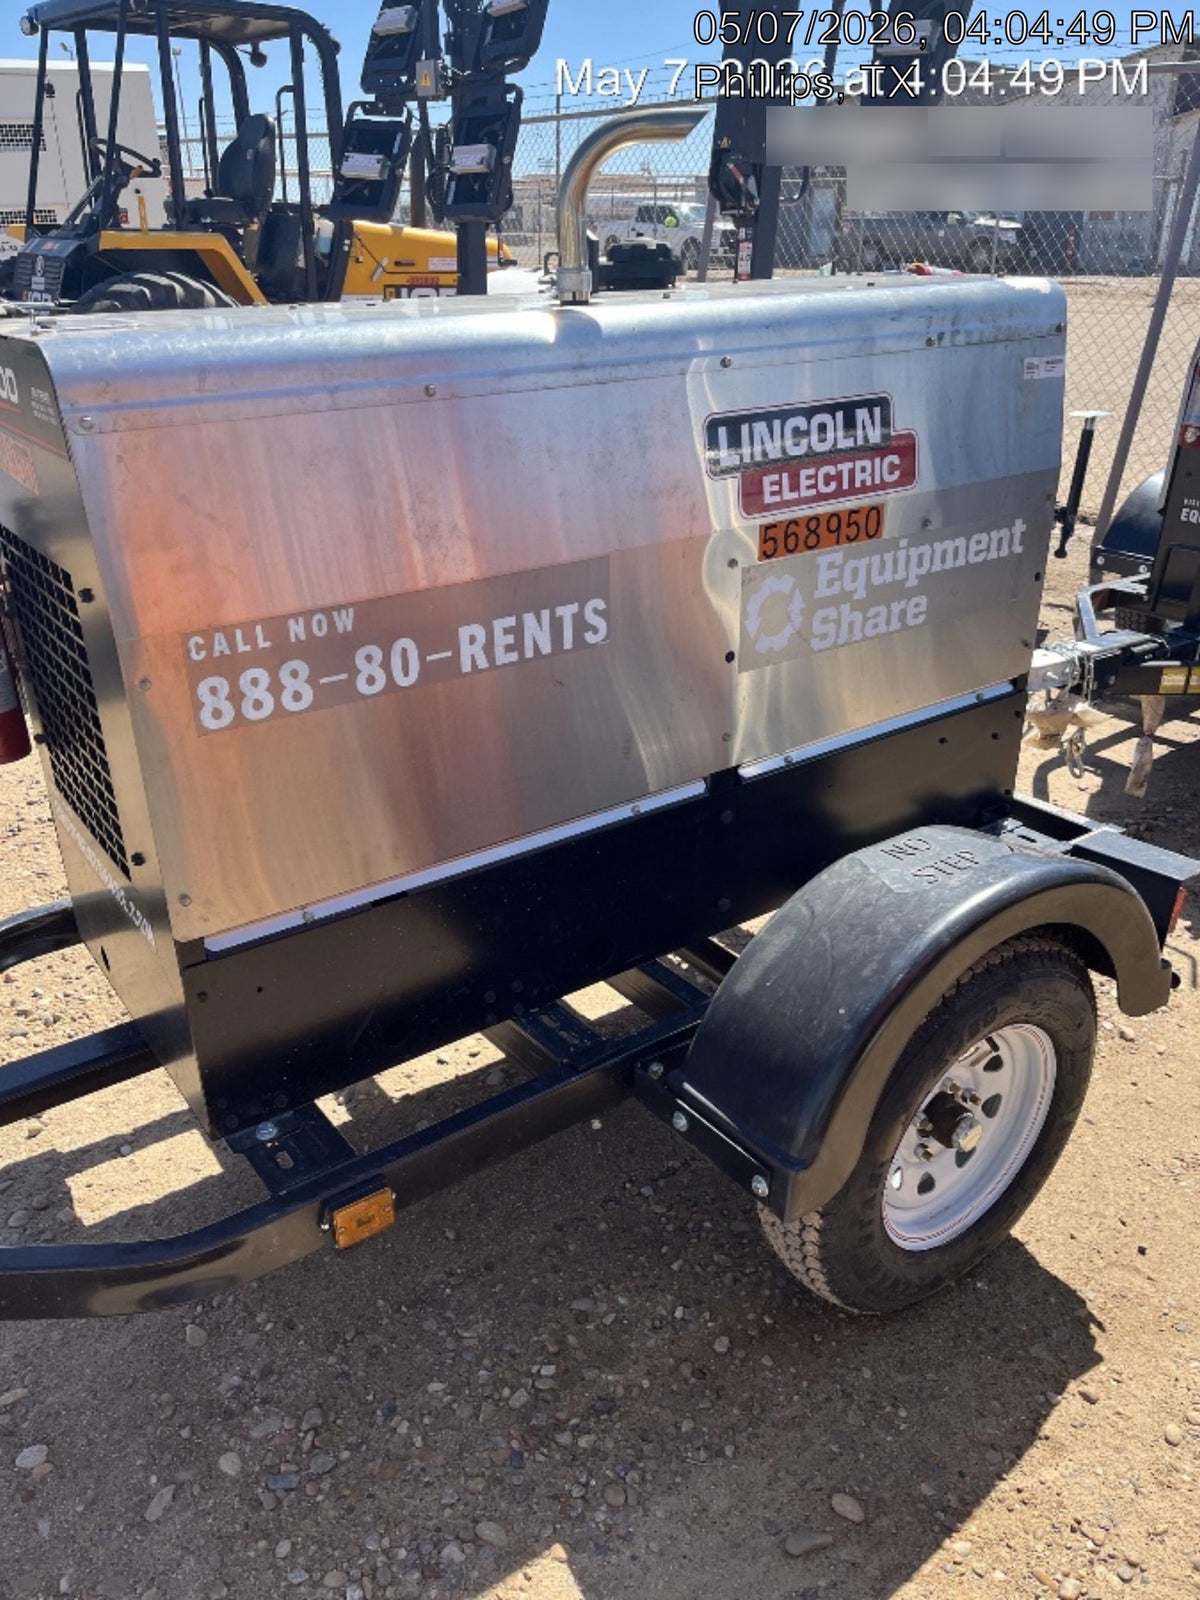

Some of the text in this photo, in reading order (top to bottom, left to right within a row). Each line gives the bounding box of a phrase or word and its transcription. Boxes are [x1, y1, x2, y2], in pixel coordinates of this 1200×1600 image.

[718, 406, 882, 466] LINCOLN
[762, 454, 901, 504] ELECTRIC
[761, 506, 882, 559] 568950
[815, 518, 1027, 600] Equipment
[187, 608, 356, 662] CALL NOW
[810, 593, 928, 652] Share
[197, 598, 609, 729] 888-80-RENTS
[912, 850, 980, 885] STEP
